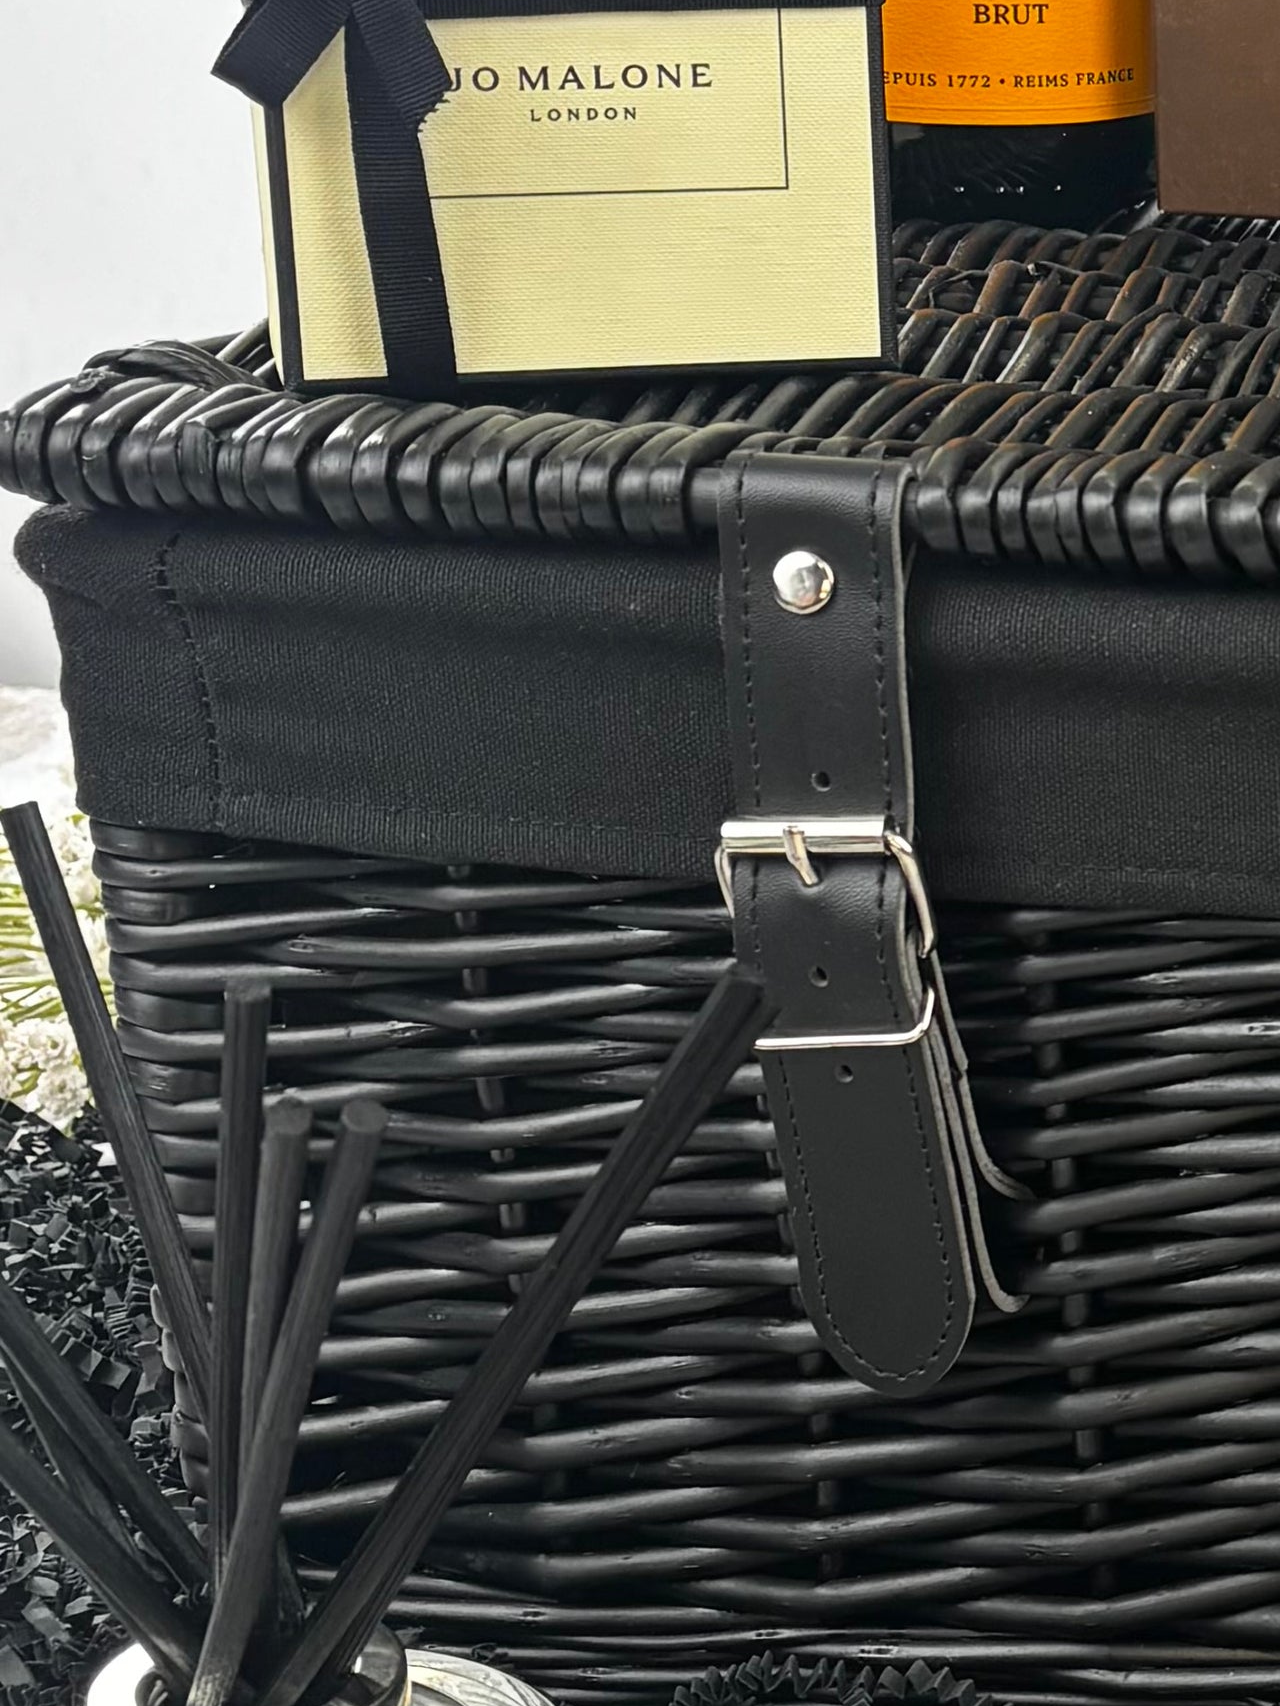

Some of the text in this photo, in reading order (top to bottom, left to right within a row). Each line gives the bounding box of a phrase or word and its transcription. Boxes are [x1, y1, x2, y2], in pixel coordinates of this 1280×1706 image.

[972, 3, 1049, 25] BRUT
[450, 63, 713, 93] JO MALONE
[883, 67, 1134, 88] EPUIS 1772 REIMS FRANCE
[530, 106, 637, 122] LONDON
